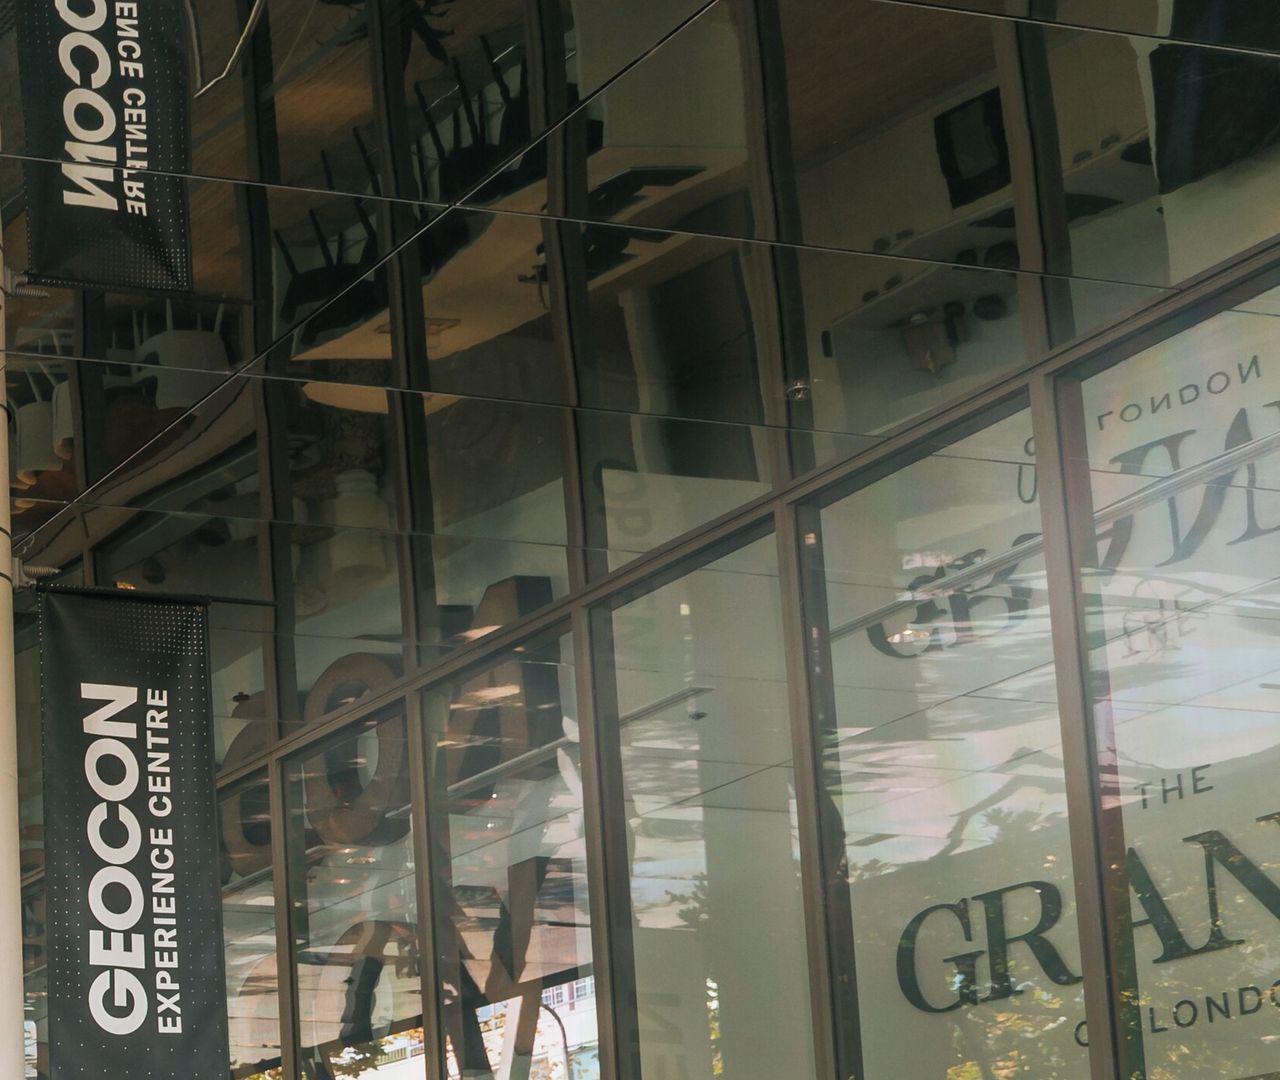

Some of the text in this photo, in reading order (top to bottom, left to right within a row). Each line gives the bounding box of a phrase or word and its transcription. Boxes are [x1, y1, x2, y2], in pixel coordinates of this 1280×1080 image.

[80, 682, 148, 1035] GEOCON
[146, 688, 183, 1034] EXPERIENCE CENTRE
[1133, 764, 1215, 810] THE
